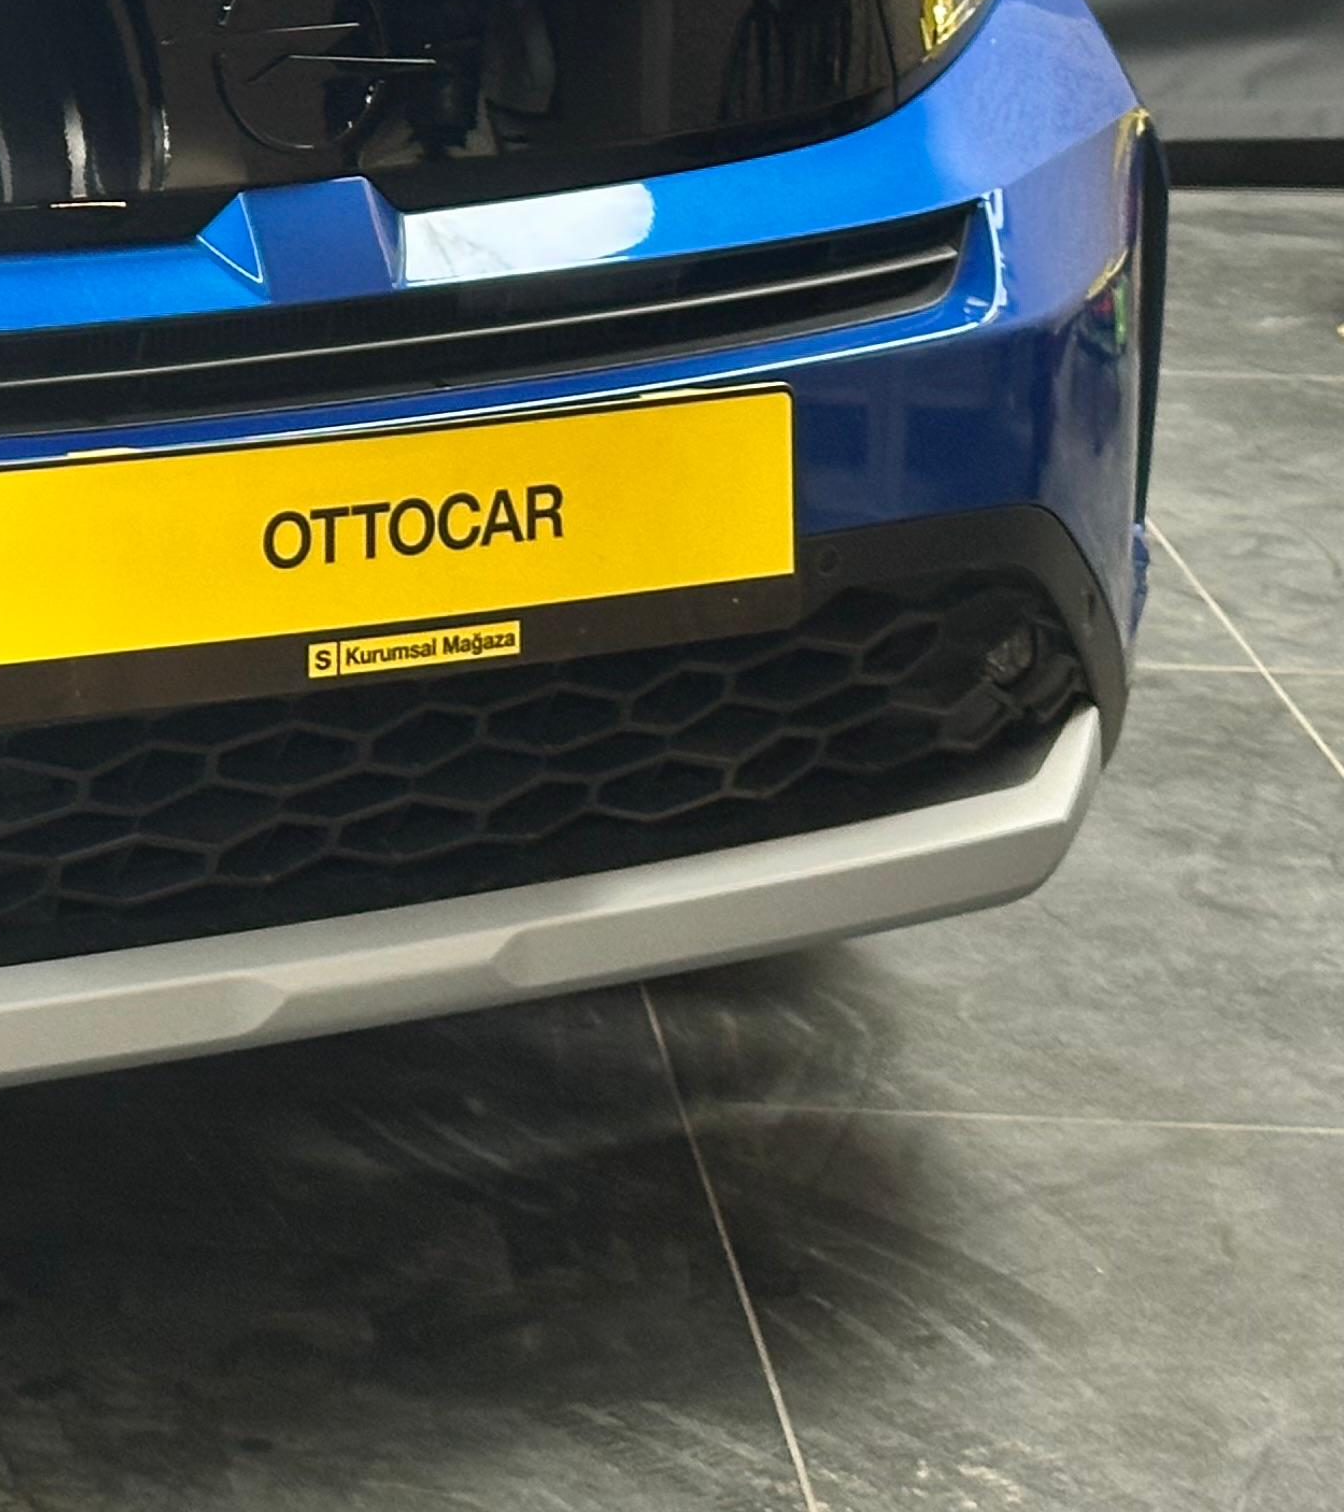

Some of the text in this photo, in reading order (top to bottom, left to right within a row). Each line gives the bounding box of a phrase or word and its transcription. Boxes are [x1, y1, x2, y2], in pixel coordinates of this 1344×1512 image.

[263, 484, 564, 570] OTTOCAR
[315, 632, 516, 670] S Kurumsal Mağaza
